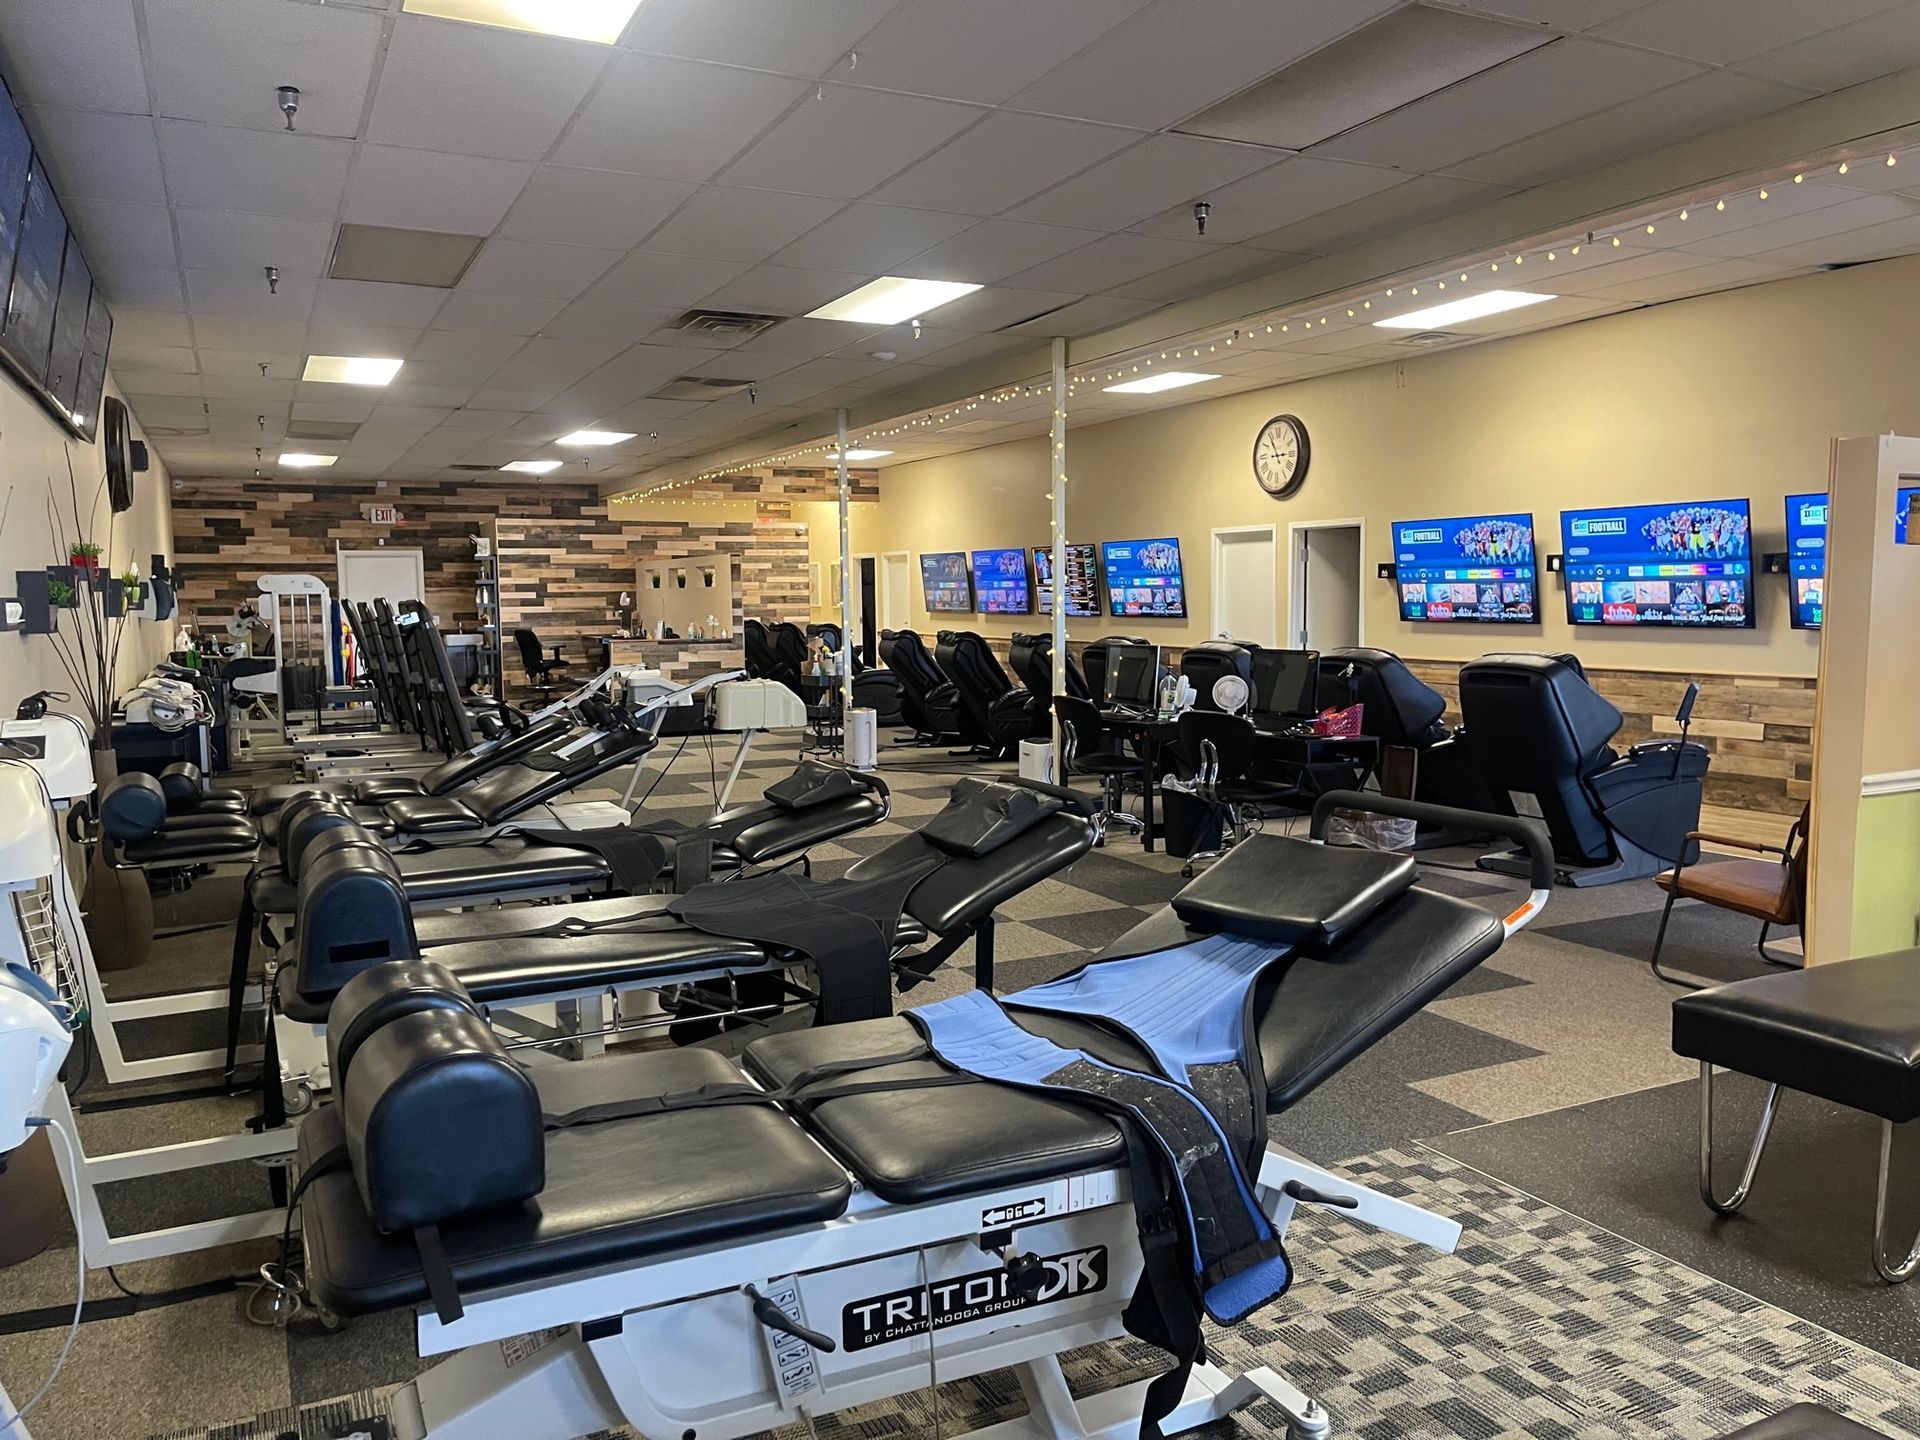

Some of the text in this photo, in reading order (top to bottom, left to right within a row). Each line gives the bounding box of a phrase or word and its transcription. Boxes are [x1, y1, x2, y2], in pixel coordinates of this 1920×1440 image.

[376, 510, 392, 521] EXIT
[1589, 521, 1623, 533] FOOTBALL
[1414, 531, 1440, 541] FOOTBALL
[864, 1332, 881, 1344] BY
